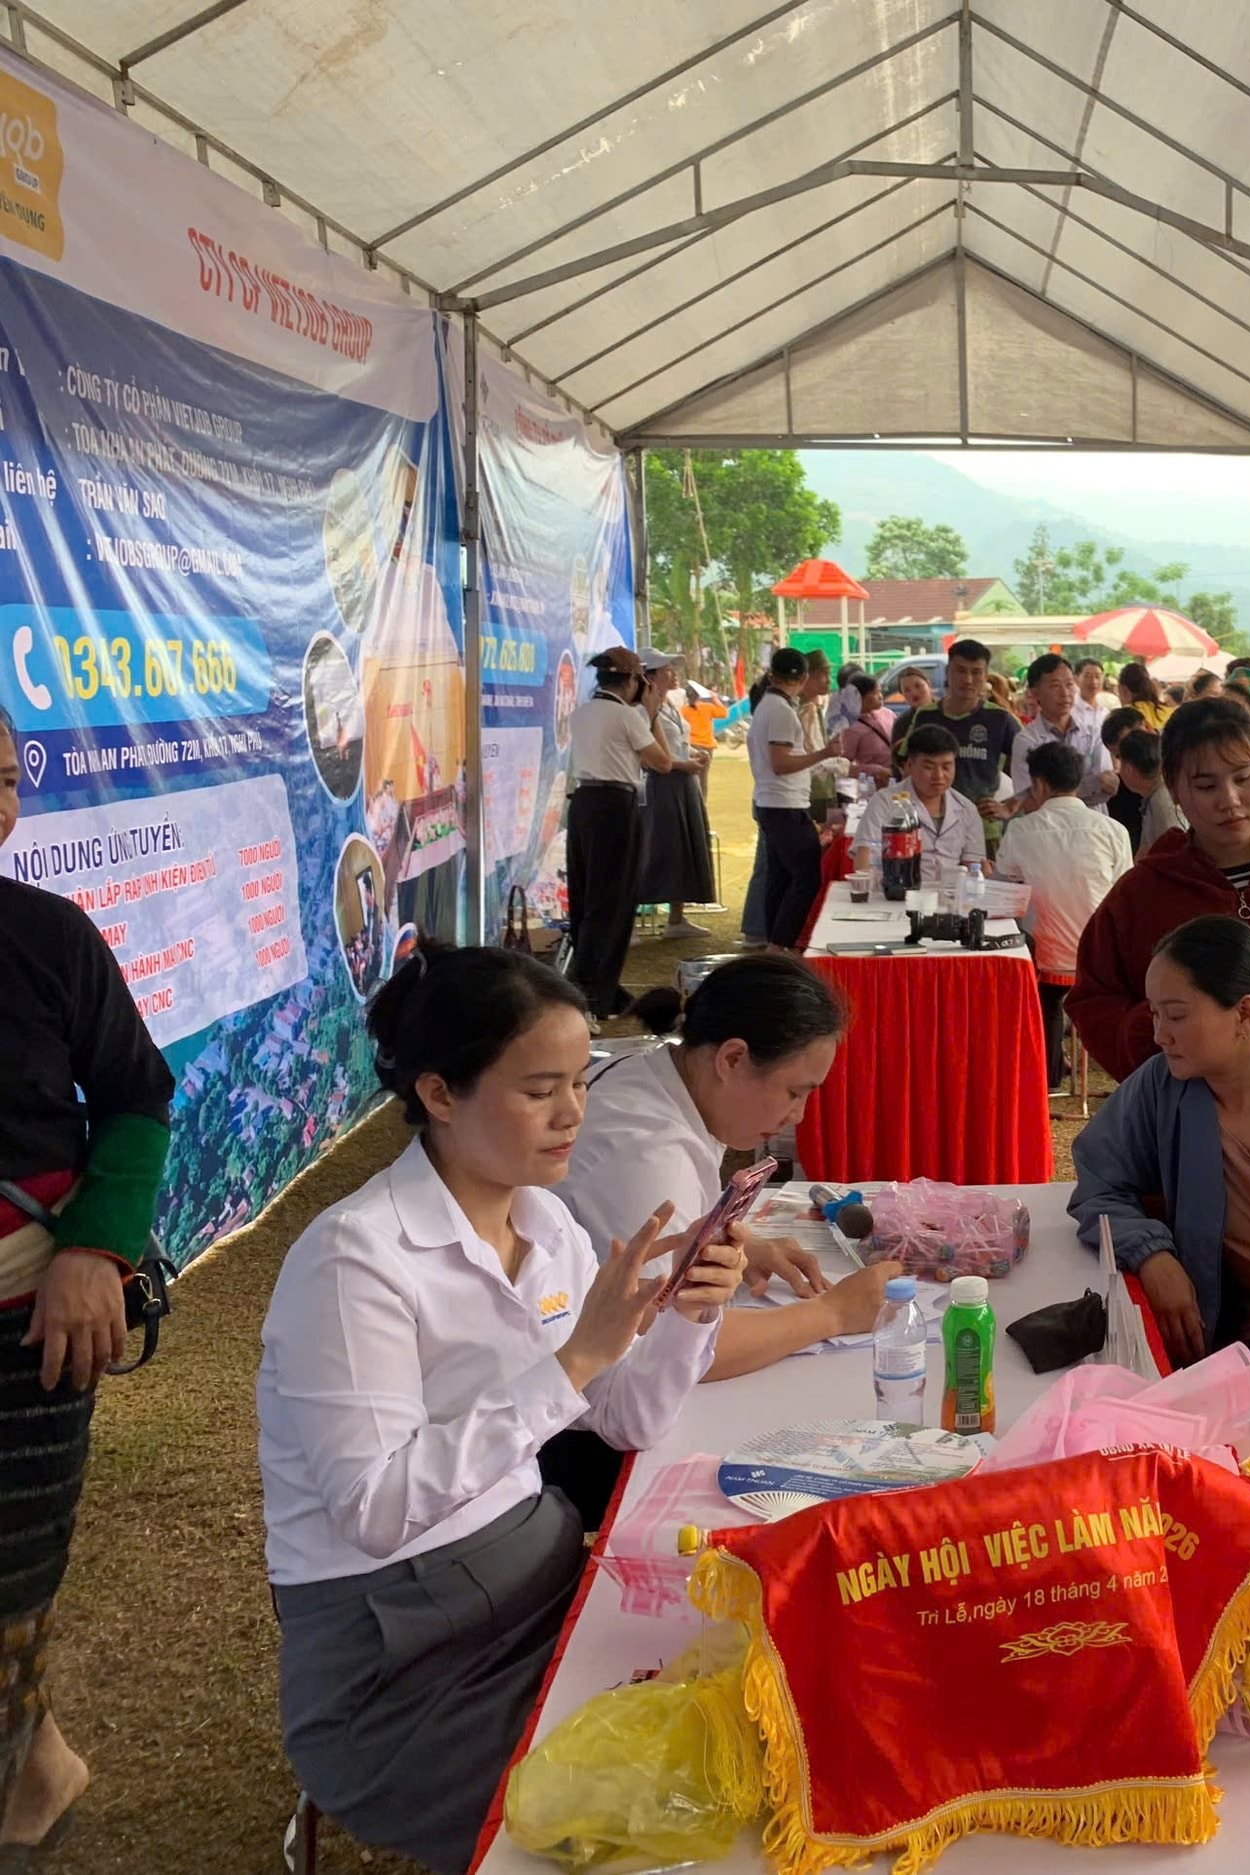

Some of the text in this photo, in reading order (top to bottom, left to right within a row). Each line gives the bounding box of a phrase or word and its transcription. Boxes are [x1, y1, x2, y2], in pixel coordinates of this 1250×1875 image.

[3, 461, 57, 506] liên hệ
[62, 746, 87, 777] TÒA
[51, 837, 103, 877] DUNG
[836, 1552, 911, 1606] NGÀY
[920, 1537, 971, 1585] HỘI
[984, 1520, 1048, 1572] VIỆC
[1055, 1508, 1116, 1554] LÀM
[917, 1609, 939, 1626] Tri
[1024, 1590, 1045, 1608] 18
[1050, 1578, 1100, 1604] tháng
[1106, 1576, 1117, 1590] 4
[1123, 1570, 1155, 1588] năm
